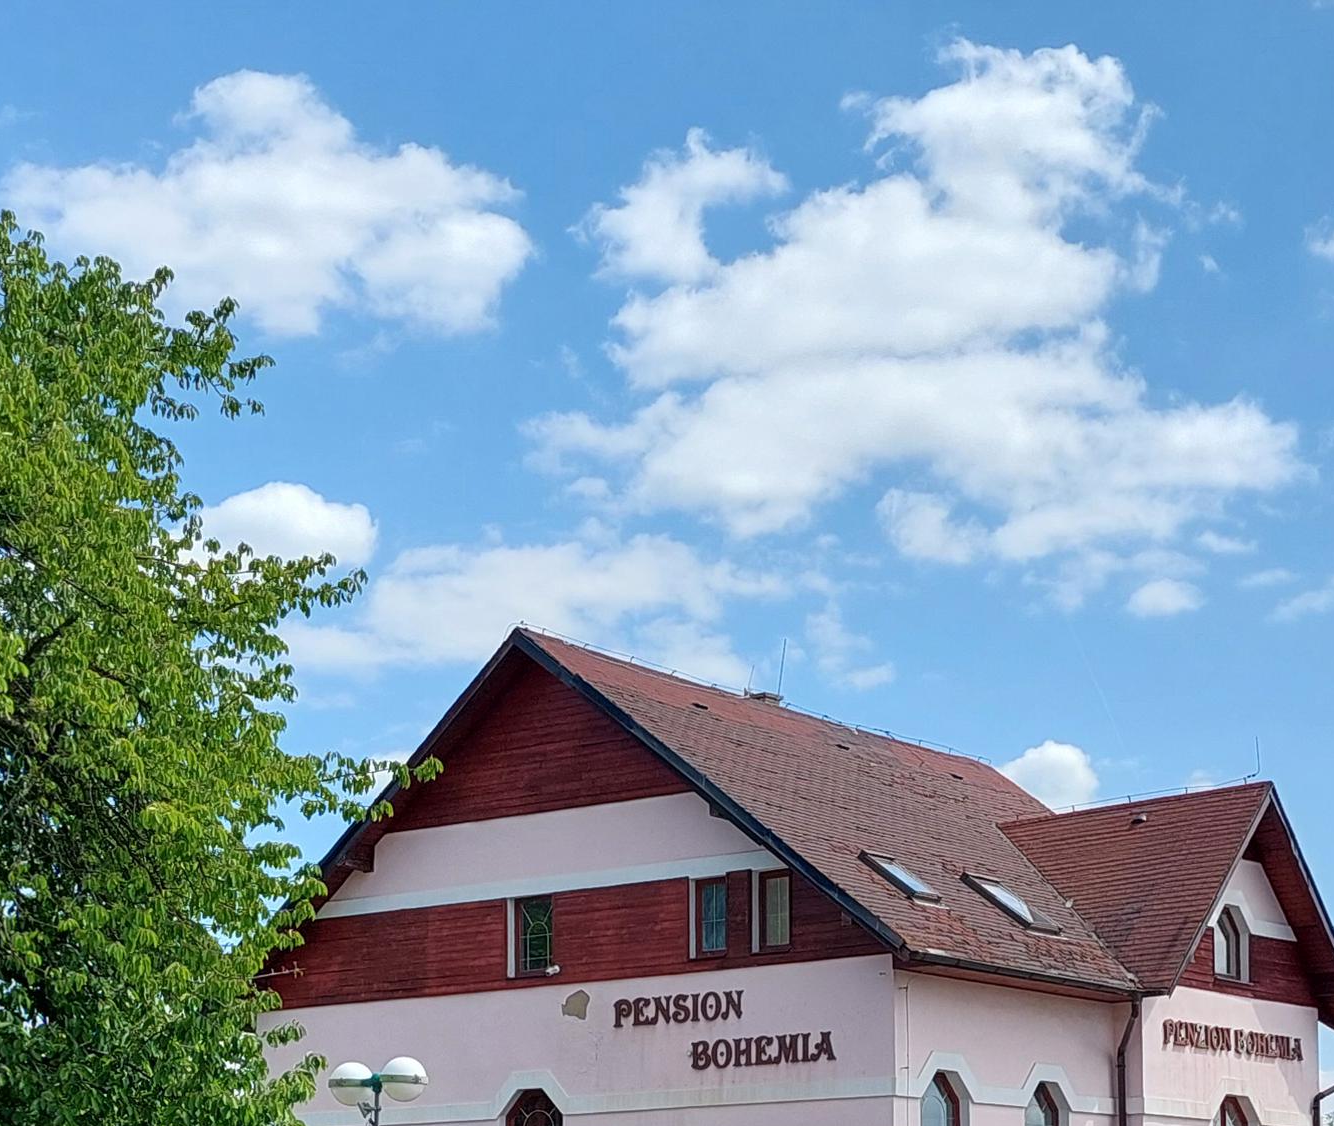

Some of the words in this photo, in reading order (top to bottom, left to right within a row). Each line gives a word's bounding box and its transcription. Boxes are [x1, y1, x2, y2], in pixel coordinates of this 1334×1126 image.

[613, 990, 744, 1028] PENSION
[690, 1031, 837, 1070] BOHEMIA
[1234, 1029, 1304, 1062] BOHEMIA
